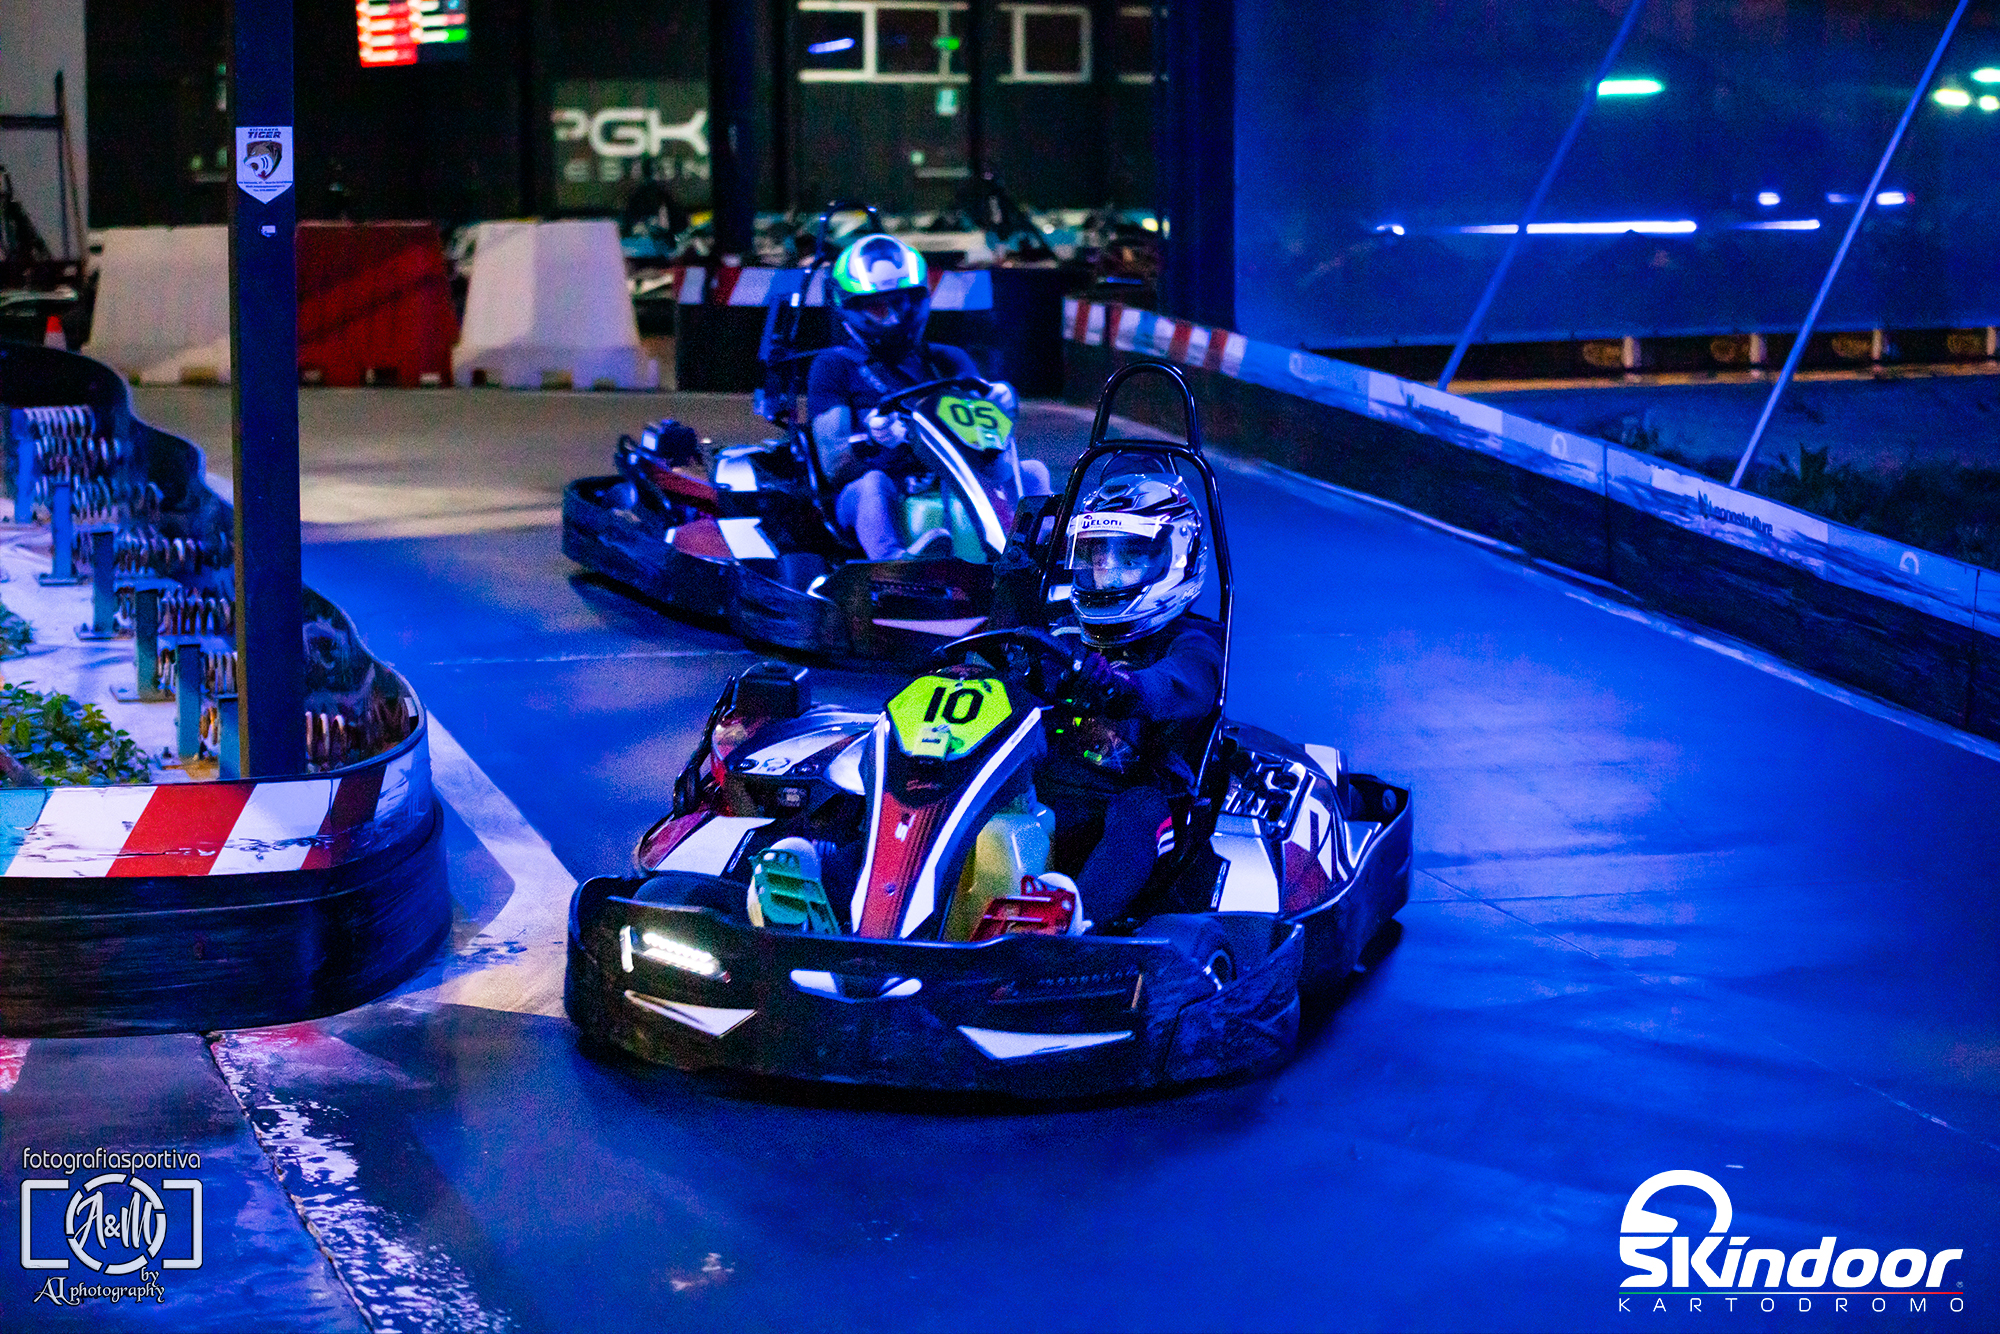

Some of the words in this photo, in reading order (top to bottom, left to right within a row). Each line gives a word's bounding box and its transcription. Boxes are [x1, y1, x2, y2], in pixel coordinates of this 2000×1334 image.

[247, 131, 282, 139] TIGER
[949, 403, 998, 429] 05
[923, 687, 984, 725] 10
